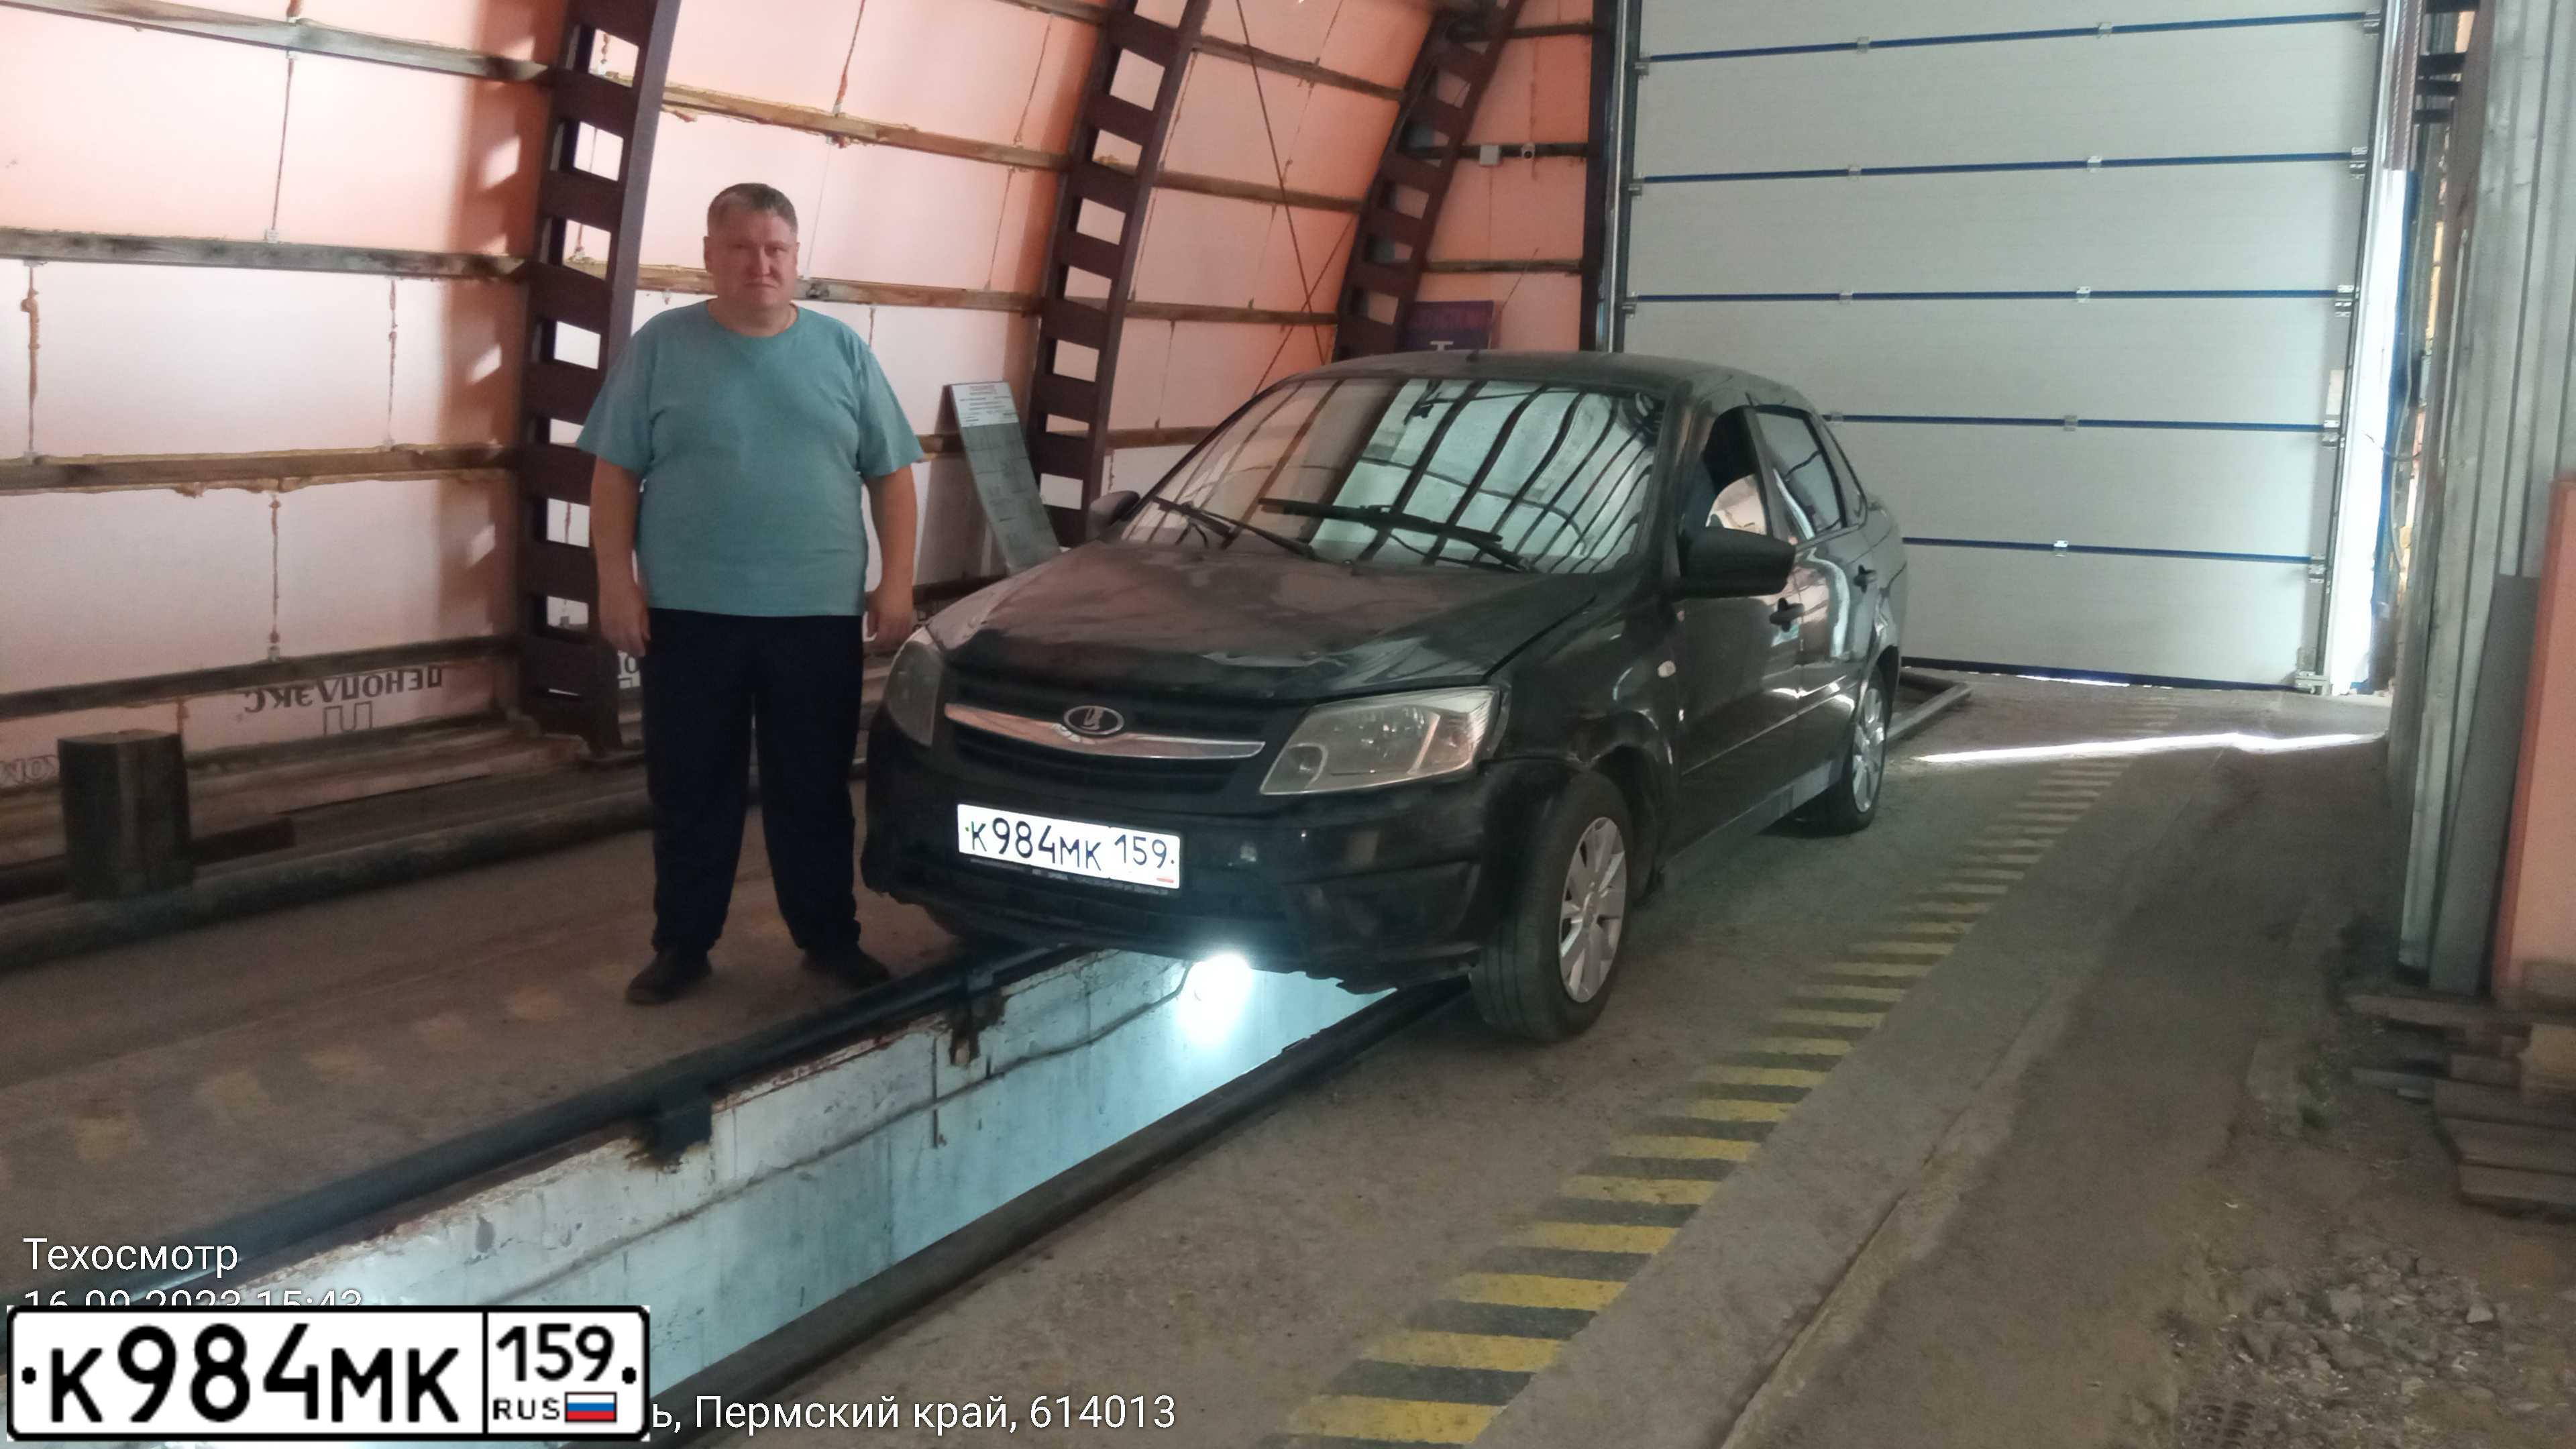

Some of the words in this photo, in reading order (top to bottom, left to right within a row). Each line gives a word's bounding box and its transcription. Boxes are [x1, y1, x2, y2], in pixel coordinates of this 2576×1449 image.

[244, 665, 442, 713] ПЕНОПЛЭКС
[971, 816, 1102, 871] К984МК
[1114, 834, 1168, 869] 159
